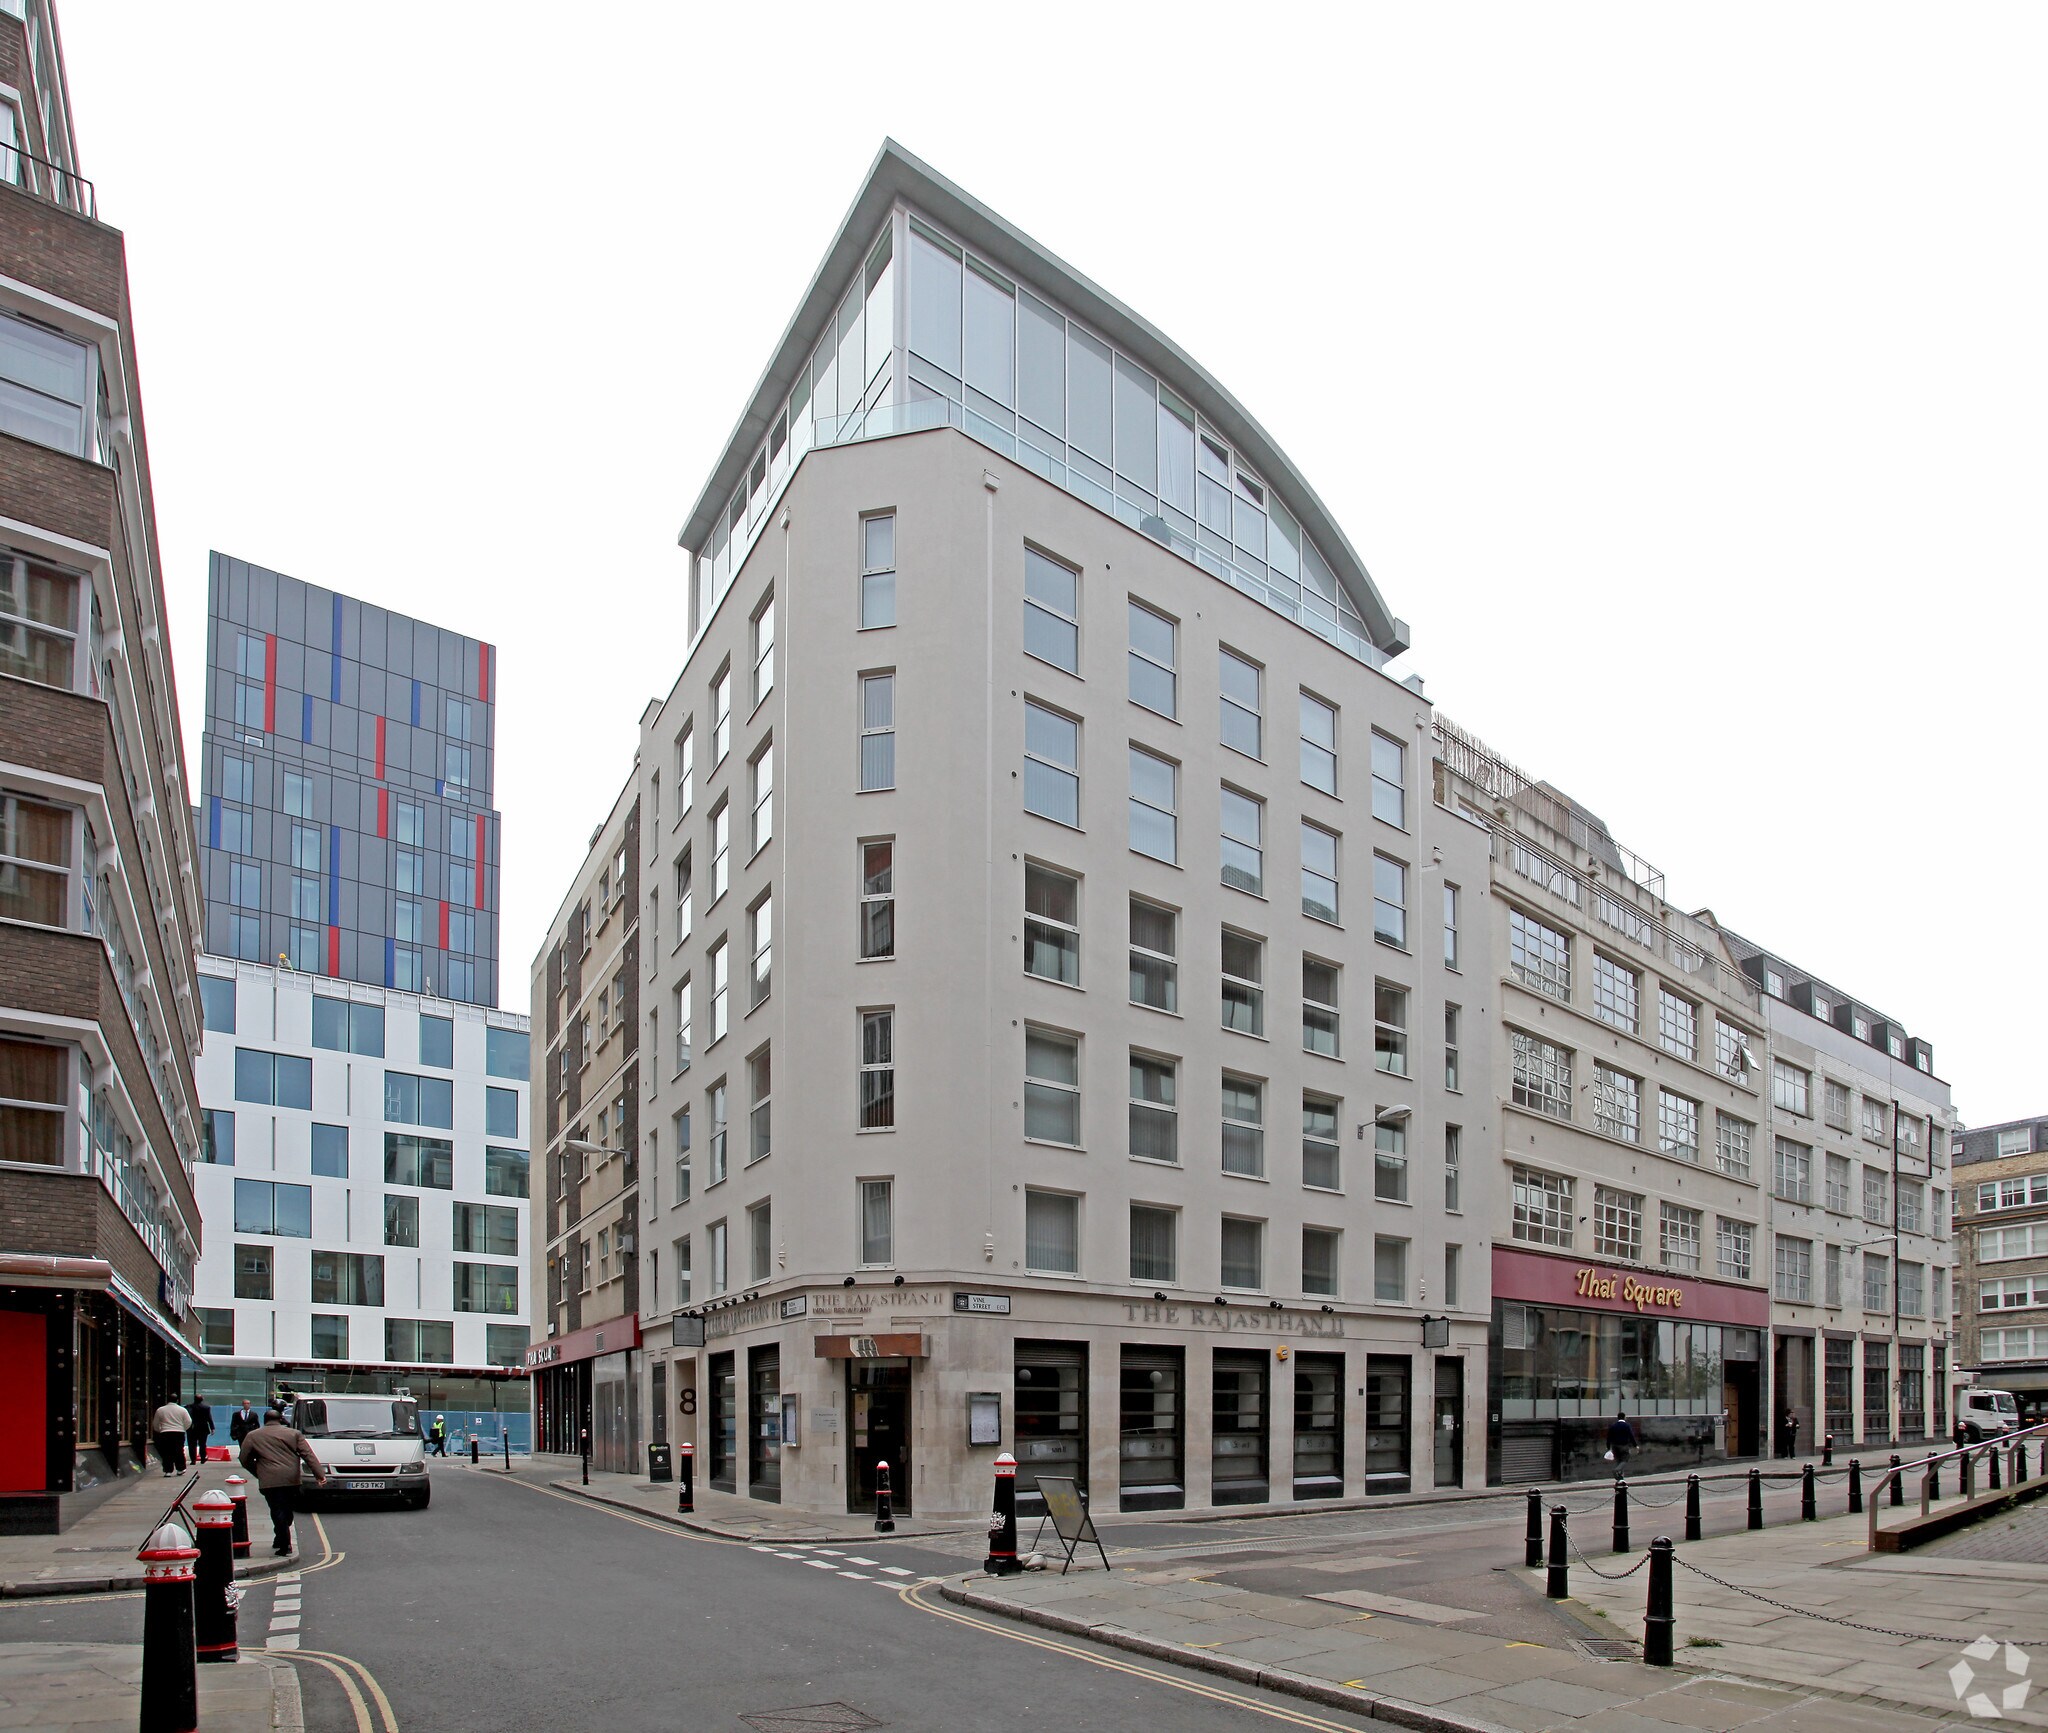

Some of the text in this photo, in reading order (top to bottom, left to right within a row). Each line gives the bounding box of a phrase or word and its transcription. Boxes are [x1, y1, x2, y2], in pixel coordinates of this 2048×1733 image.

[812, 1293, 841, 1307] THE
[845, 1291, 930, 1307] RAJASTHAN
[1576, 1268, 1683, 1312] Thai Square
[1121, 1303, 1180, 1324] THE
[1190, 1307, 1324, 1332] RAJASTHAN
[680, 1388, 697, 1415] 8
